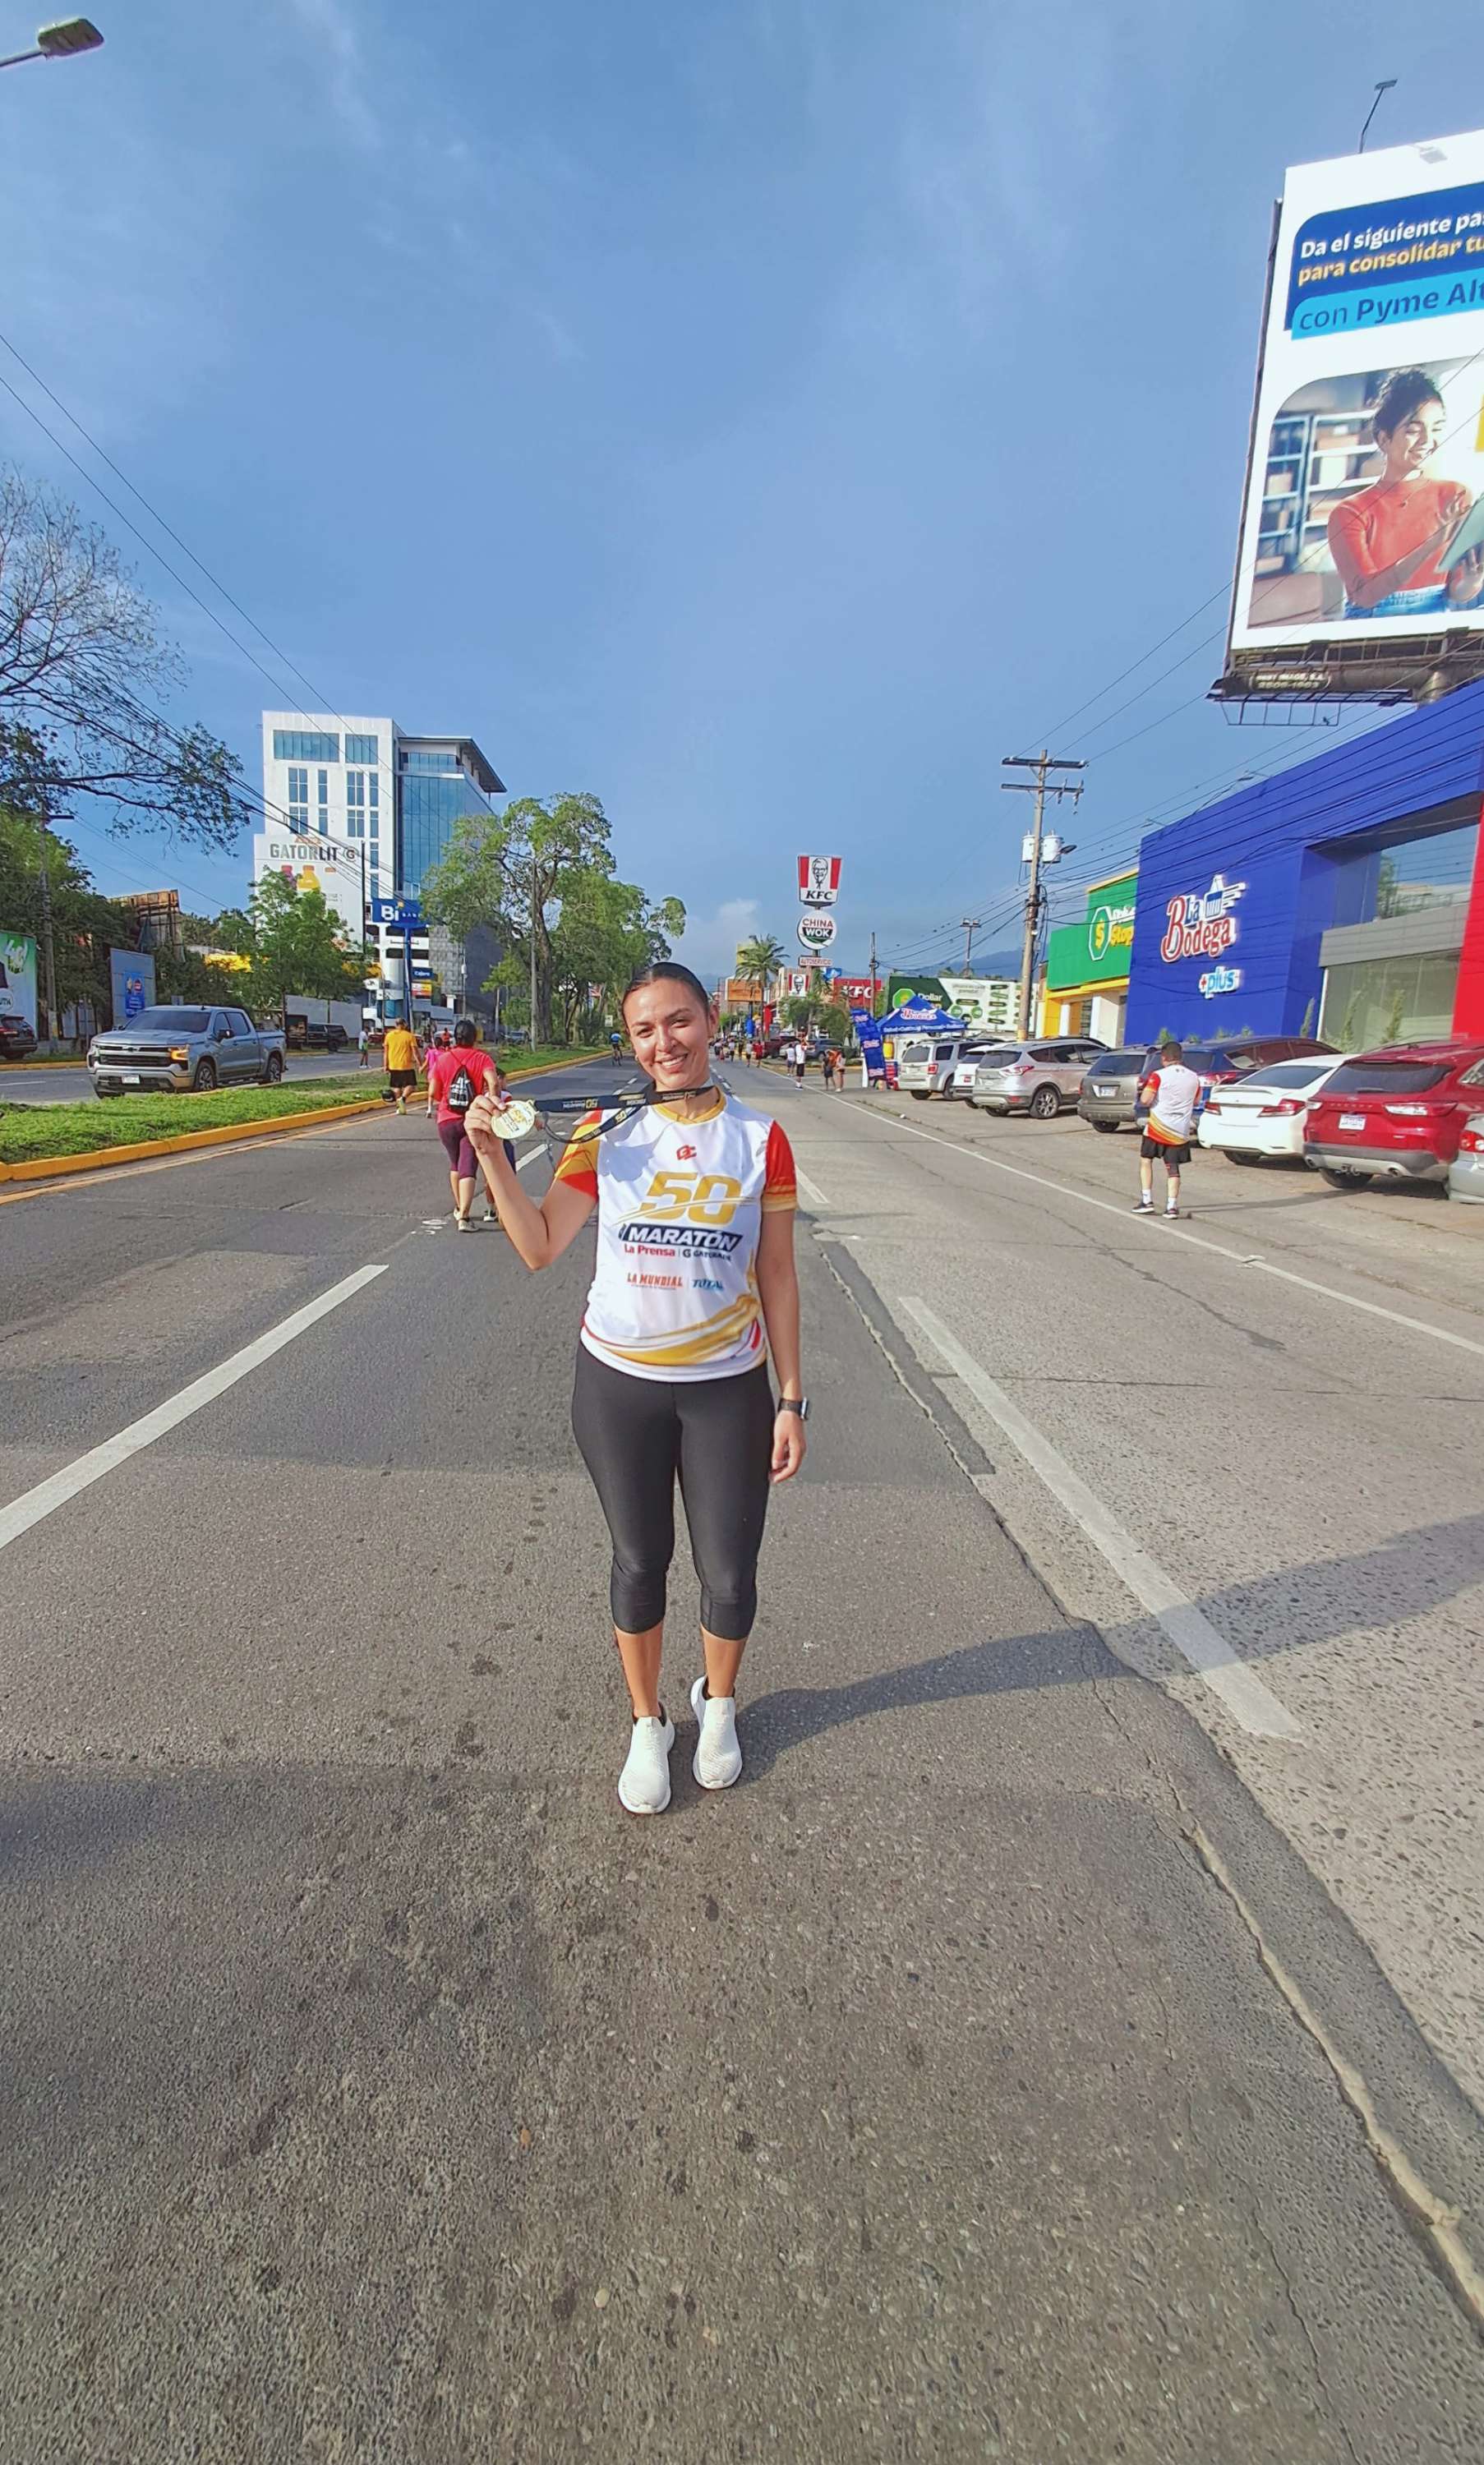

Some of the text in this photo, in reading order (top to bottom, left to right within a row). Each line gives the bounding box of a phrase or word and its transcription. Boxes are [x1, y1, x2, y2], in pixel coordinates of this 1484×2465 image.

[1301, 241, 1326, 259] Da
[1330, 233, 1350, 253] el
[1354, 217, 1450, 250] siguiente
[1298, 260, 1344, 287] para
[1349, 242, 1462, 273] consolidar
[1300, 307, 1348, 330] con
[1357, 290, 1438, 323] Pyme
[806, 890, 832, 901] KFC
[380, 905, 399, 921] Bi
[802, 918, 833, 928] CHINA
[1161, 896, 1233, 961] Bodega
[805, 928, 830, 938] WOK
[917, 993, 943, 1002] Dollar
[640, 1171, 741, 1225] 50
[628, 1226, 739, 1251] MARATÓN
[624, 1243, 635, 1254] La
[638, 1244, 675, 1257] Prensa
[627, 1273, 637, 1283] LA
[639, 1274, 683, 1288] MUNDIAL
